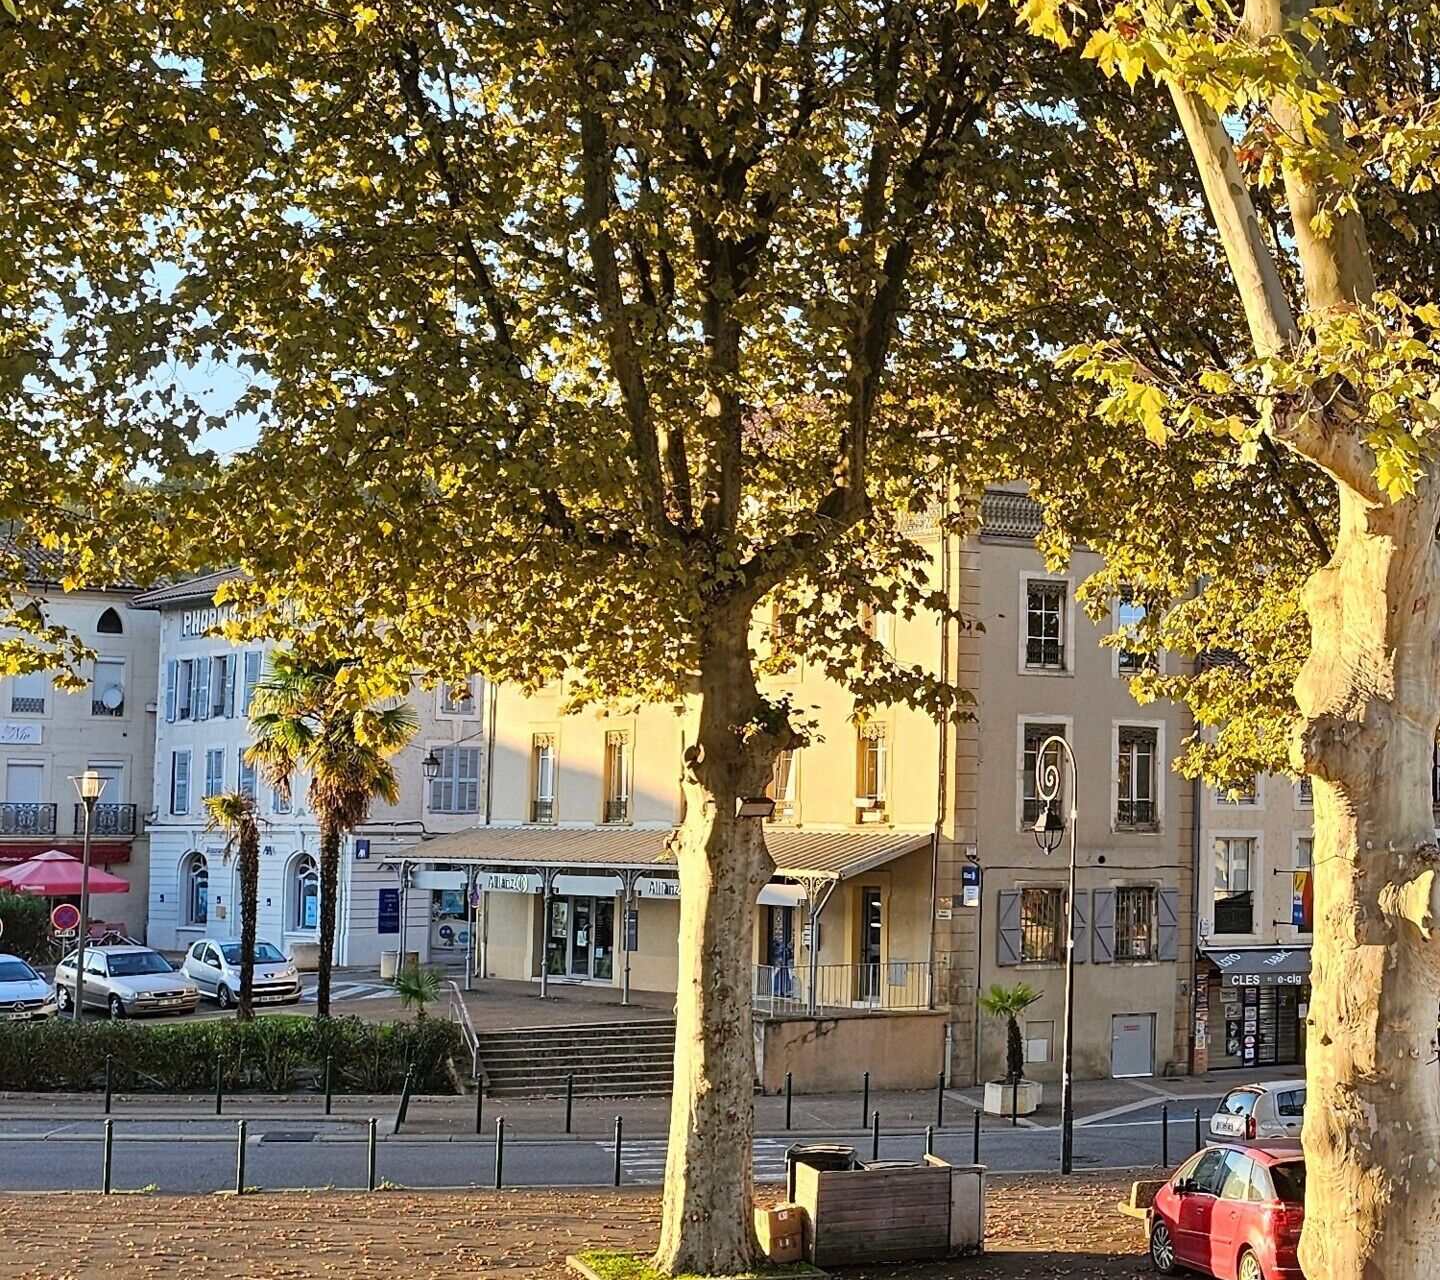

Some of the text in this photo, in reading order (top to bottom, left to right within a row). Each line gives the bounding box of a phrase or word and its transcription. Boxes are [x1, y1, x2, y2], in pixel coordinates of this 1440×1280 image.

[488, 875, 519, 891] Allianz
[1217, 953, 1241, 967] LOTO
[1231, 974, 1260, 985] CLES
[1277, 973, 1302, 986] e-cig
